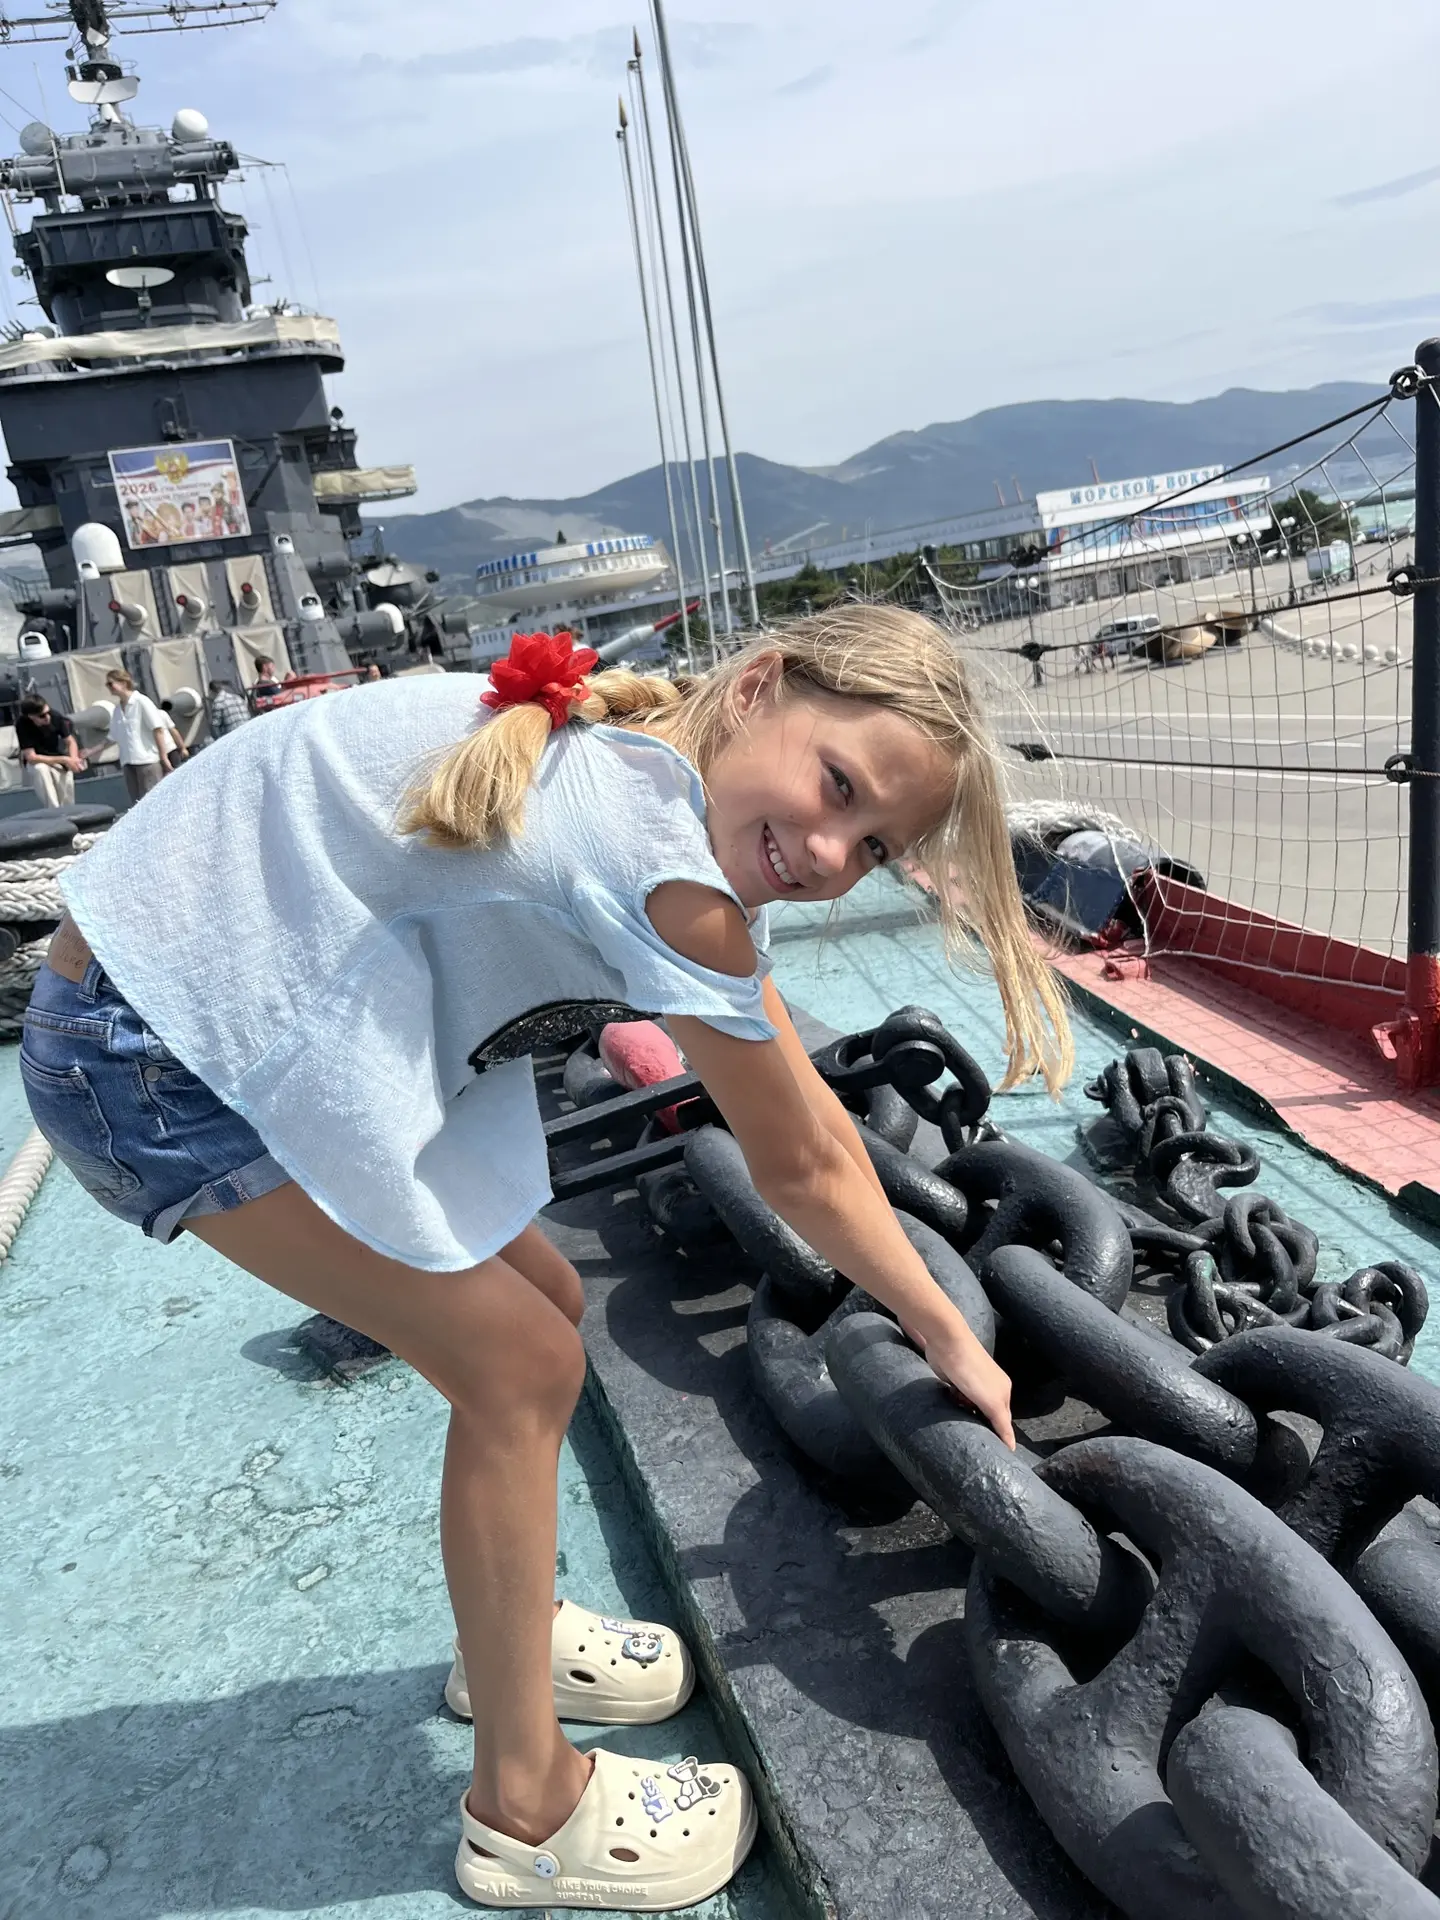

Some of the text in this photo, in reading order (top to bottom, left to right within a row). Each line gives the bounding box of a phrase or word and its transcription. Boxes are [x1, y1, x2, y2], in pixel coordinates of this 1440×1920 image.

[120, 482, 157, 496] 2026
[1069, 475, 1155, 505] МОРСКОЙ
[612, 1883, 648, 1896] CHOICE
